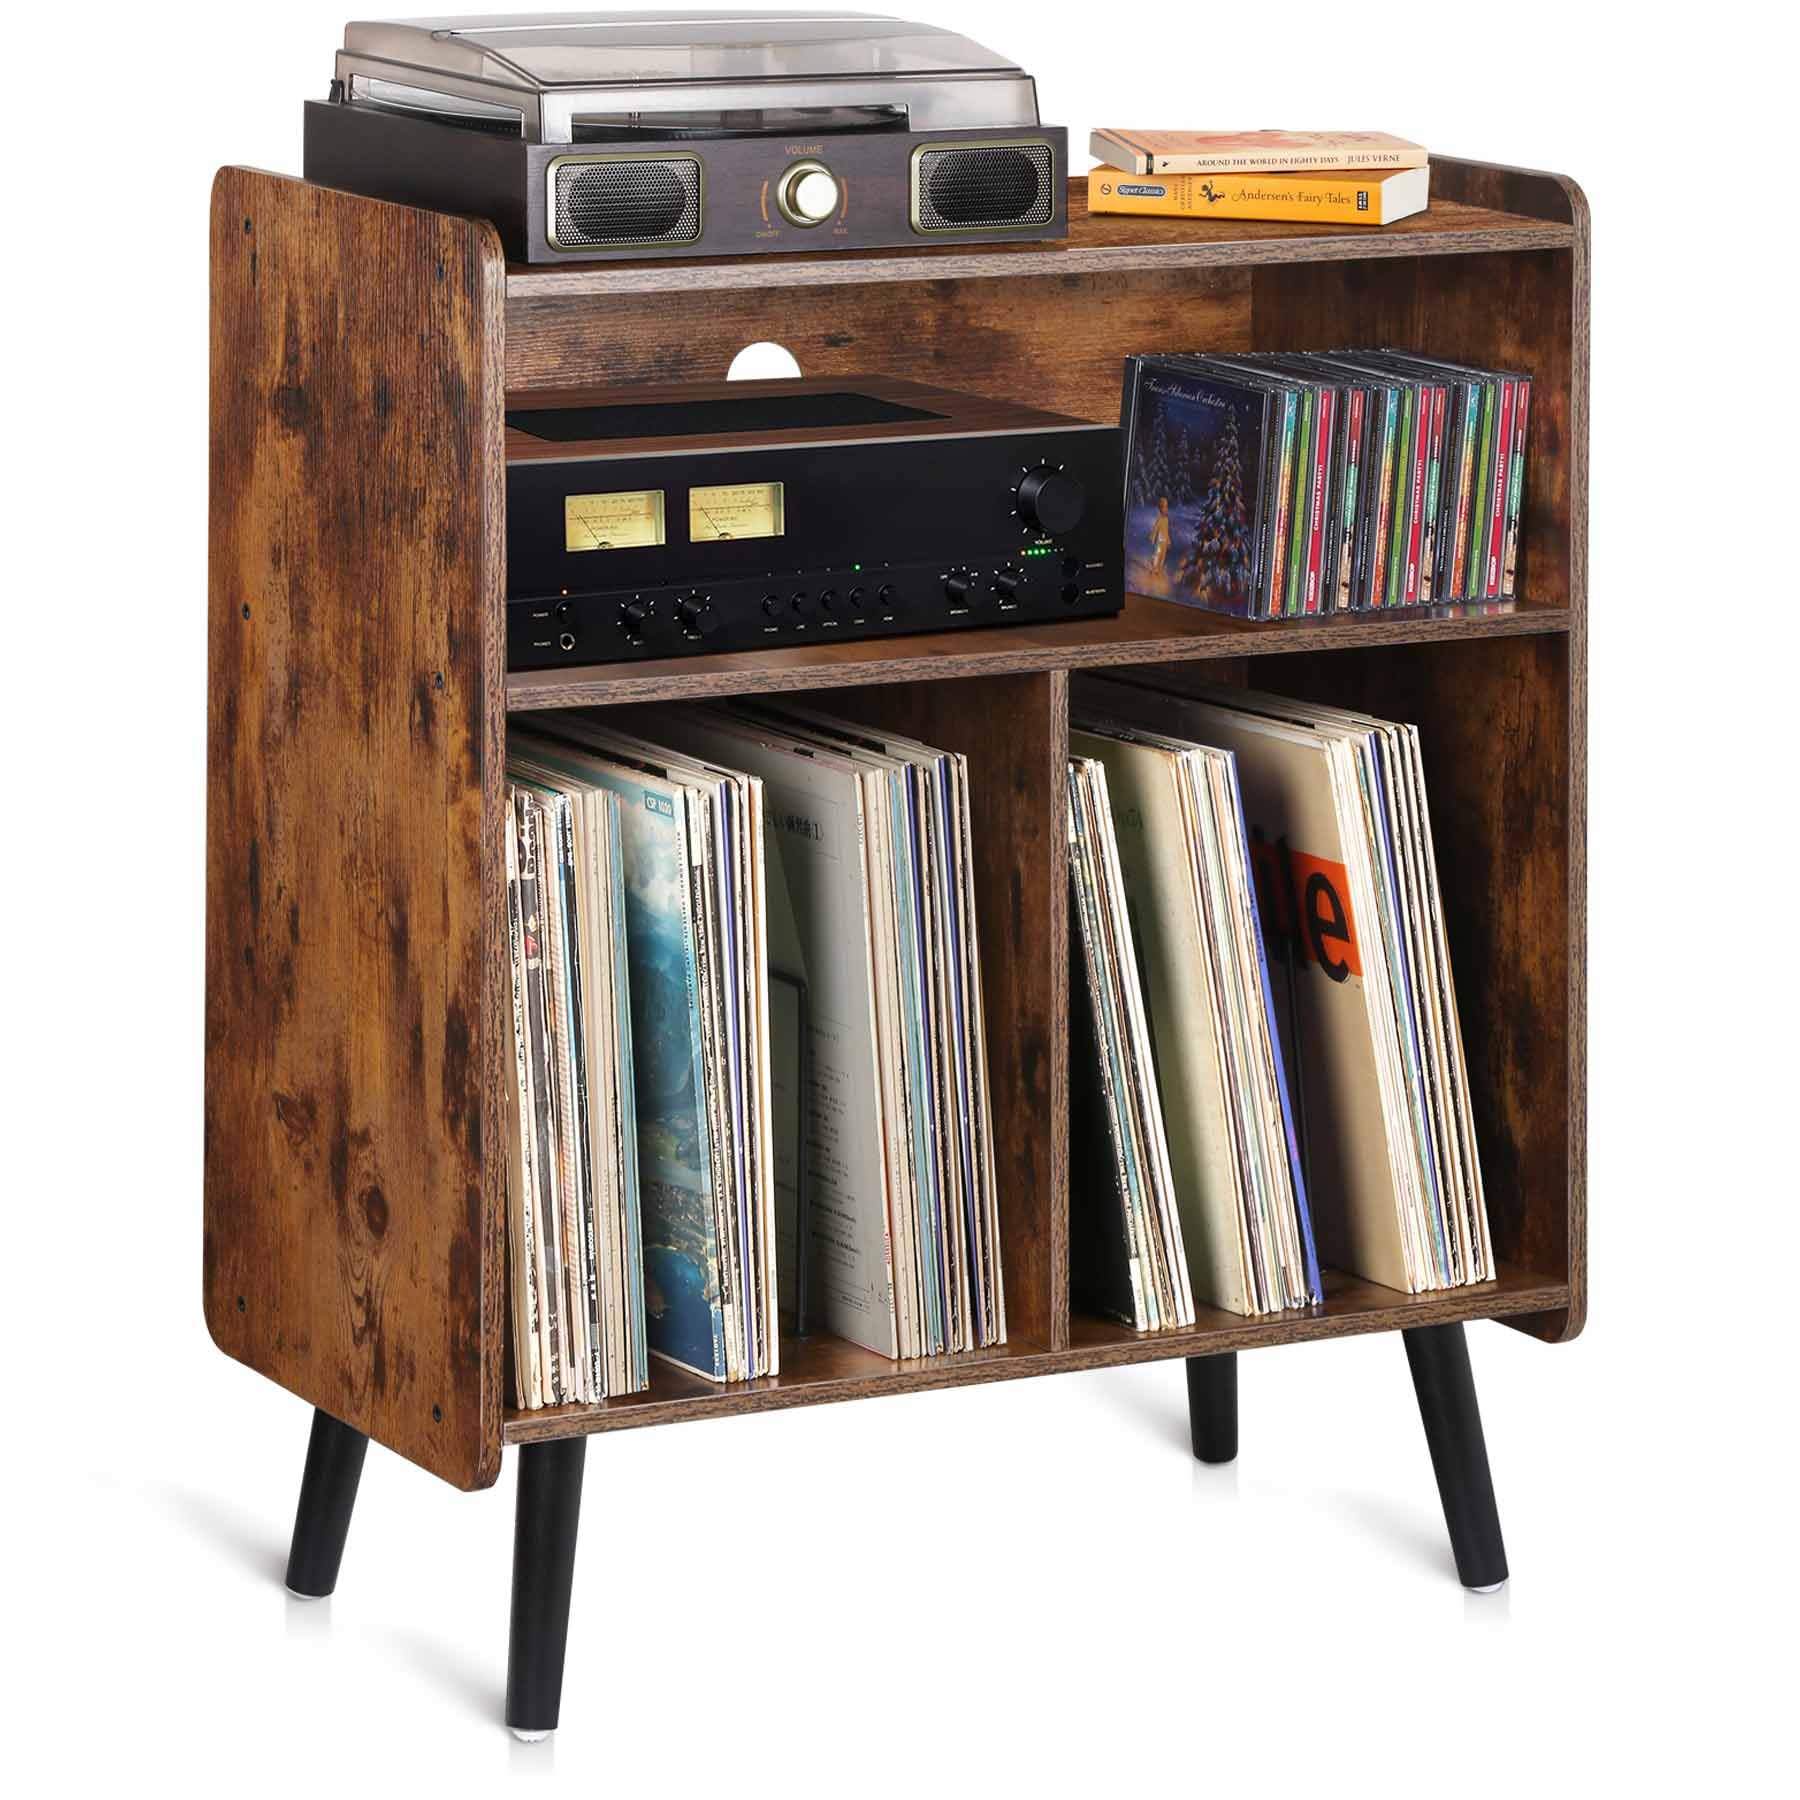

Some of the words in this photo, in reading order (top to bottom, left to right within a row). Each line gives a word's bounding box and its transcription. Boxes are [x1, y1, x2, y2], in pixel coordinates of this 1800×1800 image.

[785, 144, 824, 155] VOLUME
[1347, 154, 1371, 164] JULES
[1372, 153, 1401, 162] VERNE
[1197, 159, 1231, 167] AROUND
[1249, 158, 1278, 166] WORLD
[1320, 156, 1339, 164] DAYS
[1232, 188, 1294, 202] Andersen's
[1298, 191, 1323, 207] Fairy
[1325, 191, 1351, 204] Tales
[1413, 486, 1421, 524] CHRISTMAS
[1495, 479, 1503, 517] CHRISTMAS
[1313, 491, 1321, 531] CHRISTMAS
